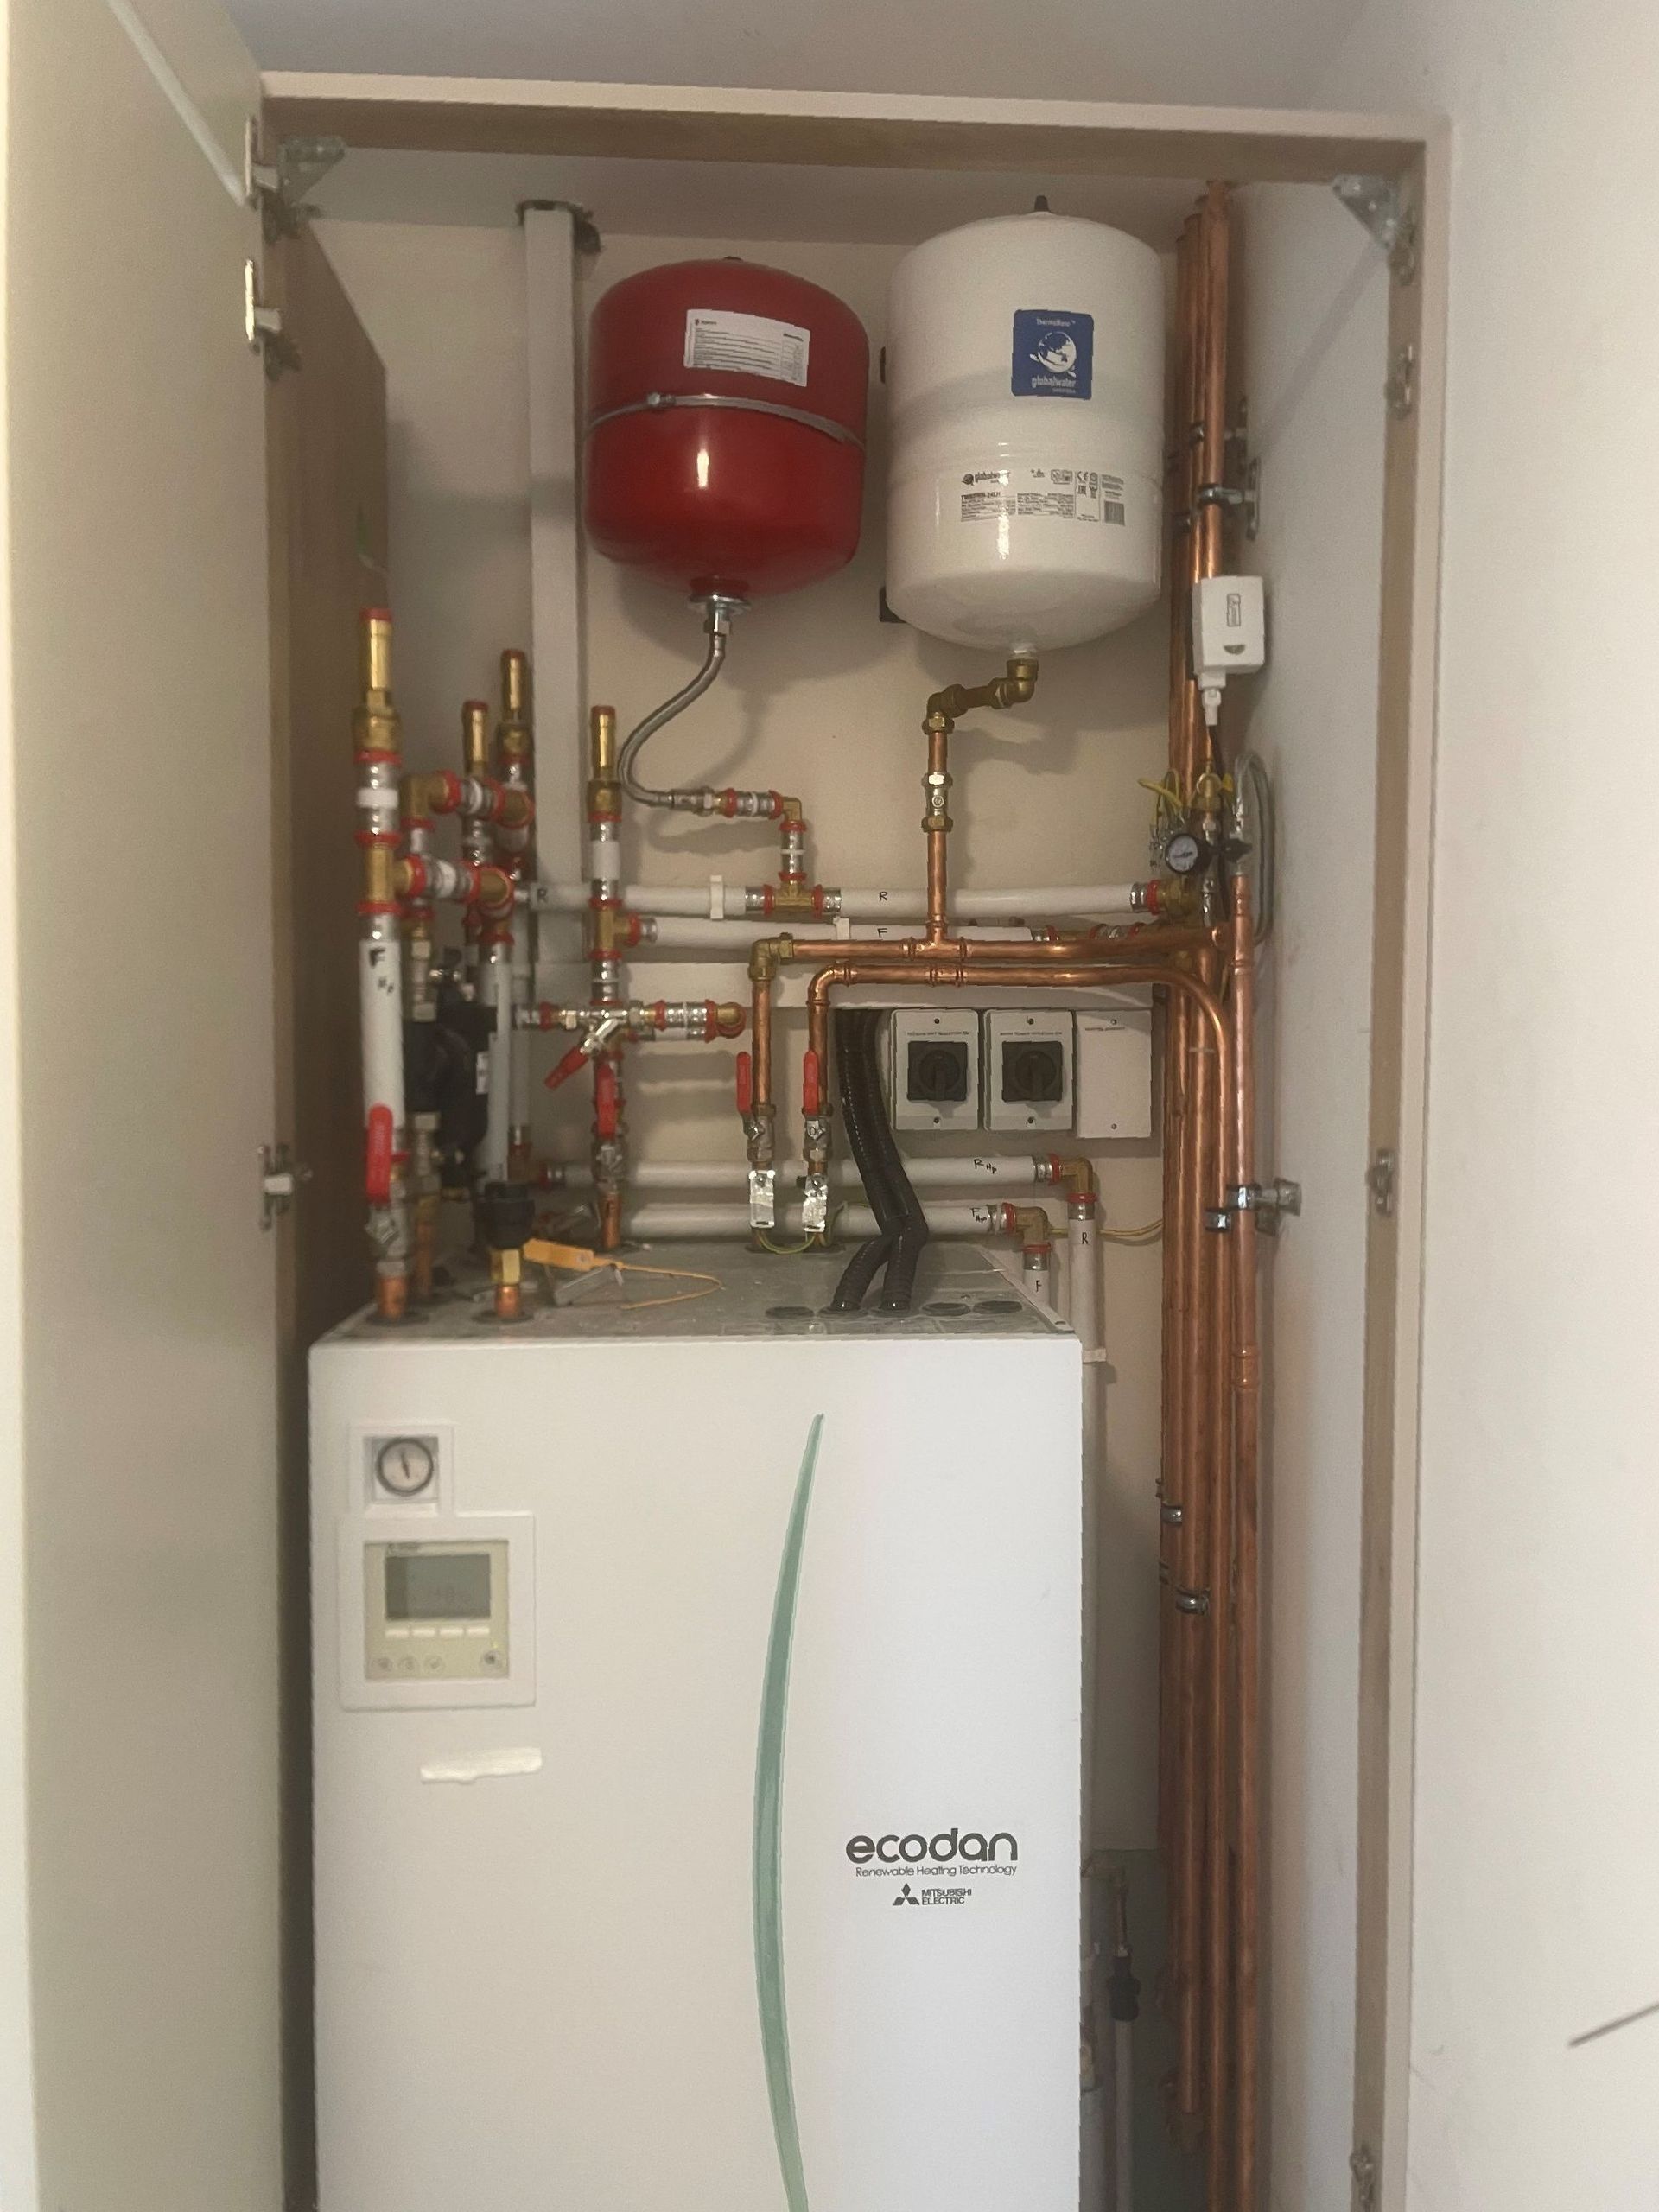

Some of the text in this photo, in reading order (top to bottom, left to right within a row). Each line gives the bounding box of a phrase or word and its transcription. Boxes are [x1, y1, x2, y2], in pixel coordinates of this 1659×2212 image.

[1031, 375, 1076, 388] globalwater
[537, 887, 550, 904] R
[879, 891, 888, 901] R
[877, 927, 888, 938] F
[1081, 1231, 1089, 1245] R
[1035, 1280, 1043, 1293] F
[846, 1827, 1018, 1864] ecodan
[855, 1865, 1018, 1878] Renewable Heating Technology
[921, 1888, 972, 1897] MITSUBISHI
[922, 1897, 965, 1906] ELECTRIC
